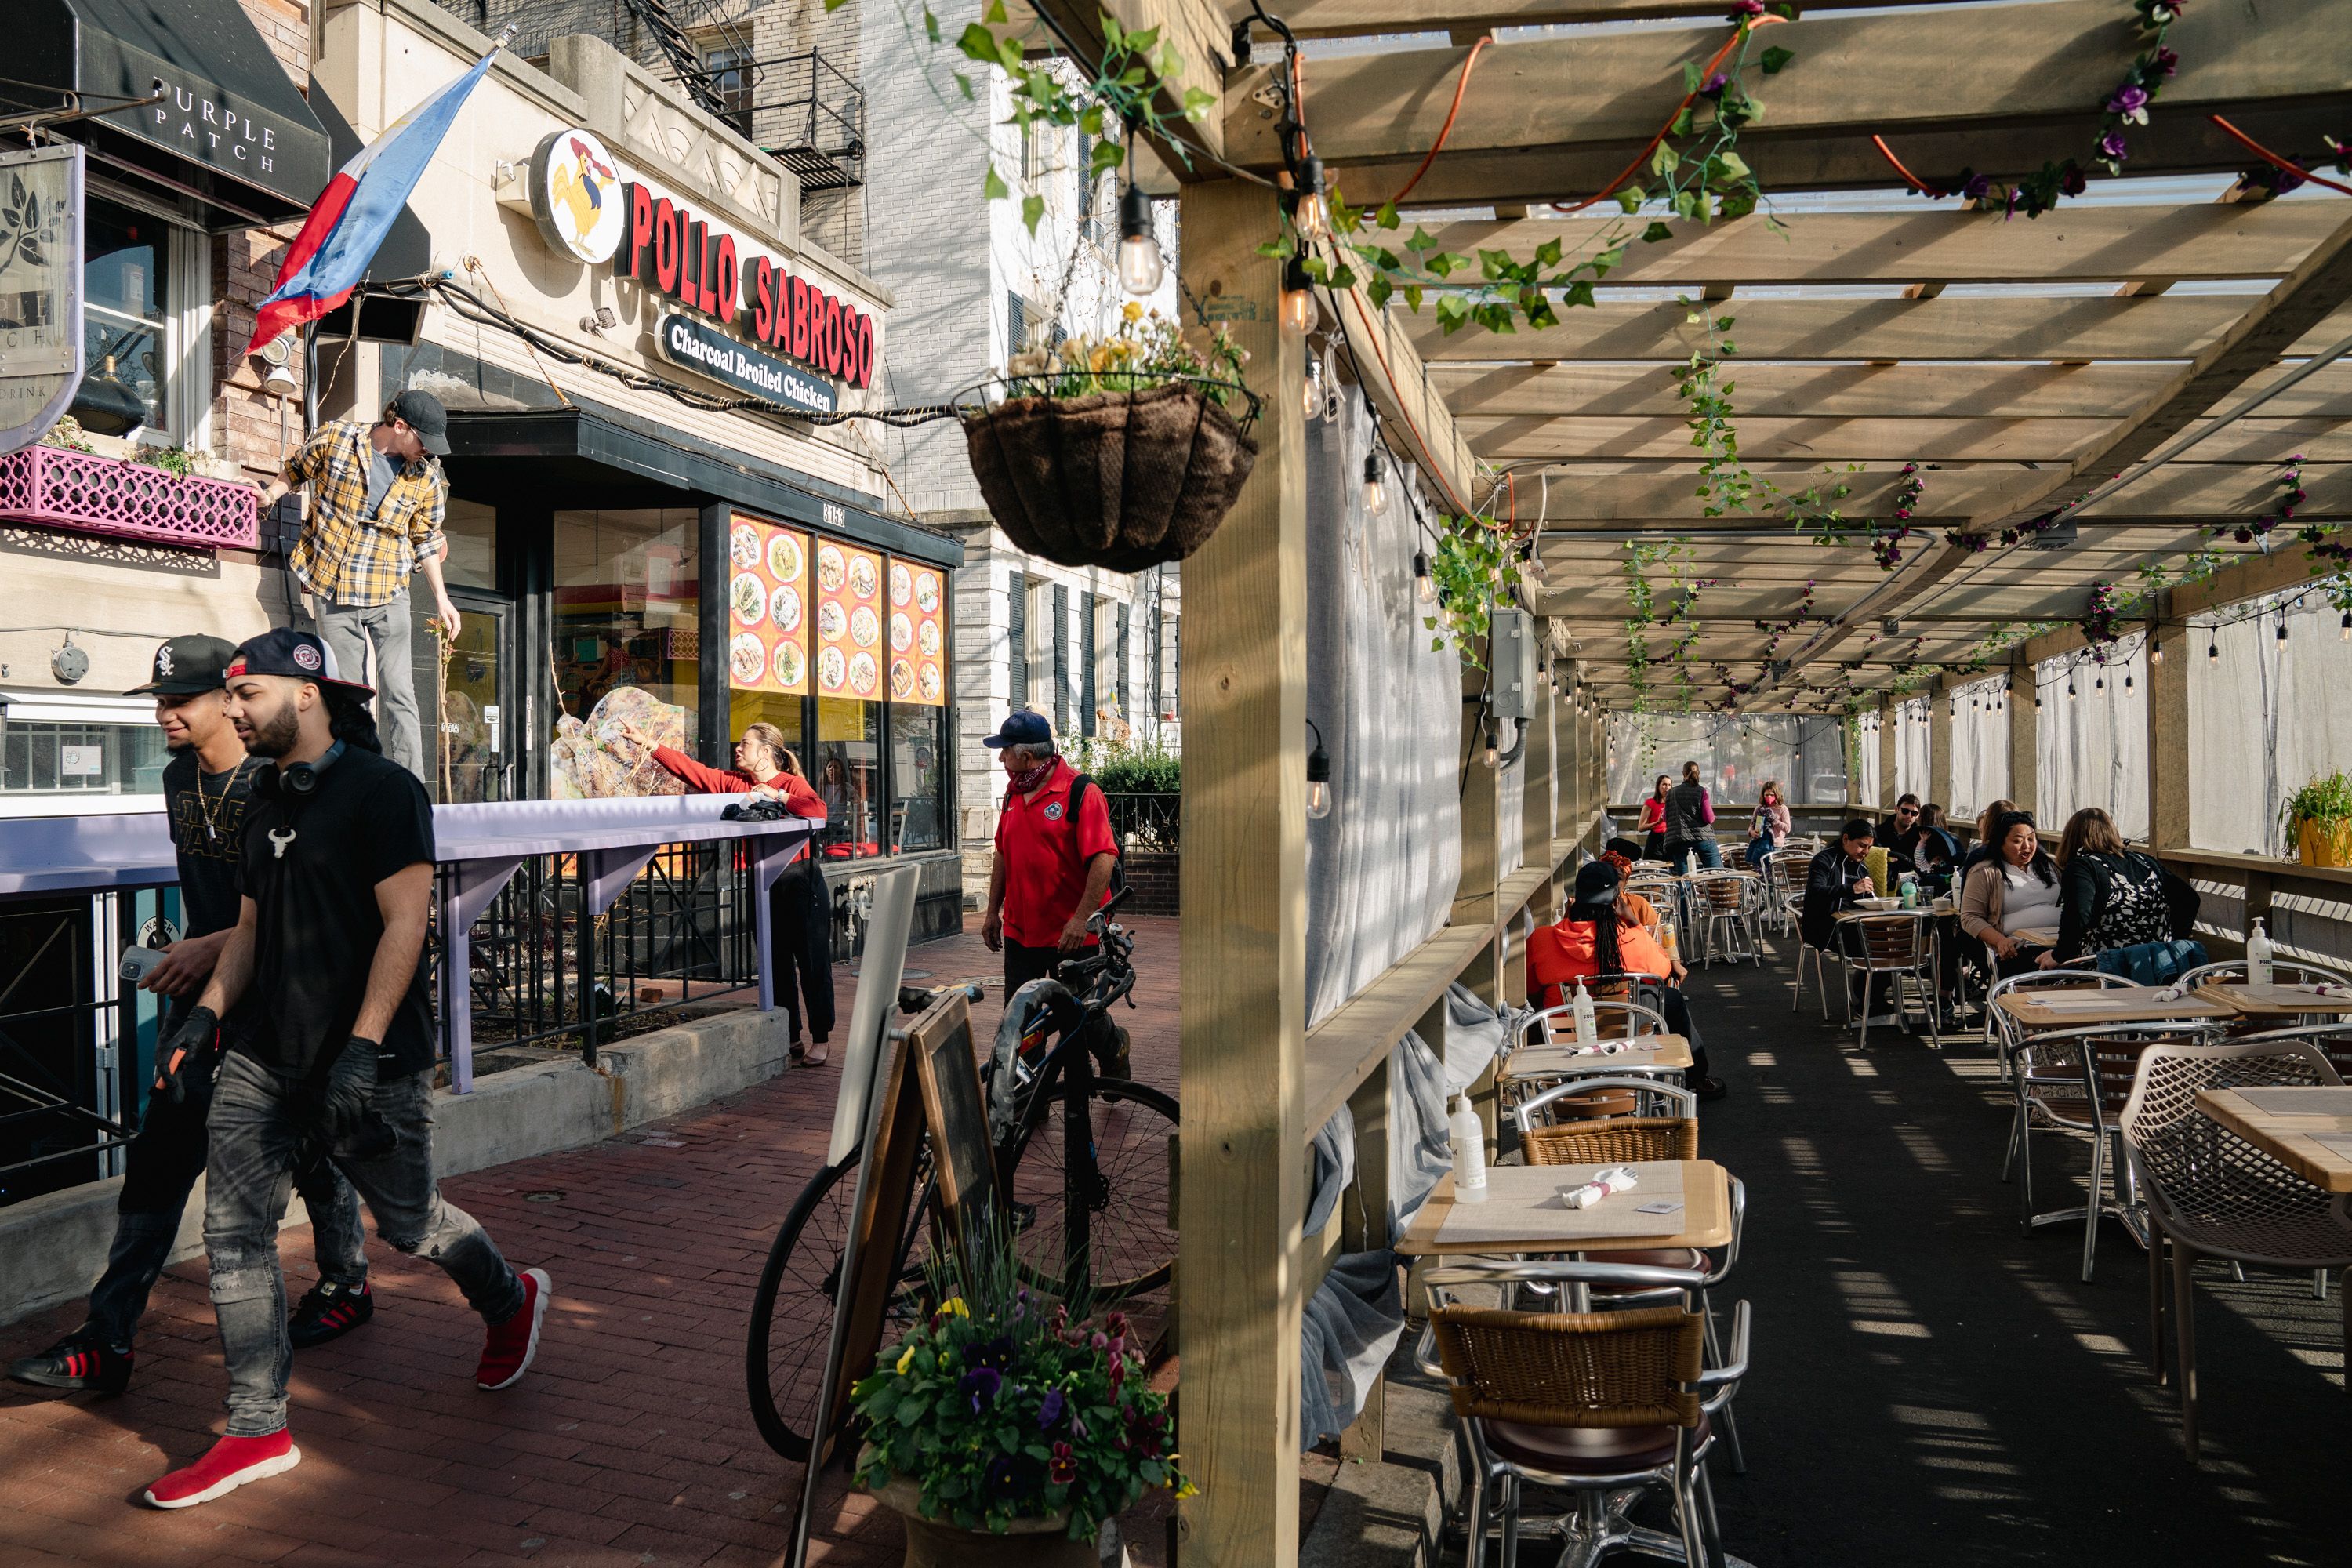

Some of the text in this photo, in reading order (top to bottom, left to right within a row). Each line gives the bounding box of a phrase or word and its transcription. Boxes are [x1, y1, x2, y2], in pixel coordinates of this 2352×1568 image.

[156, 109, 274, 172] PATCH
[630, 181, 873, 390] POLLO SABROSO
[671, 324, 831, 412] Charcoal Broiled Chicken
[824, 503, 844, 527] 3153
[144, 919, 173, 934] WACH
